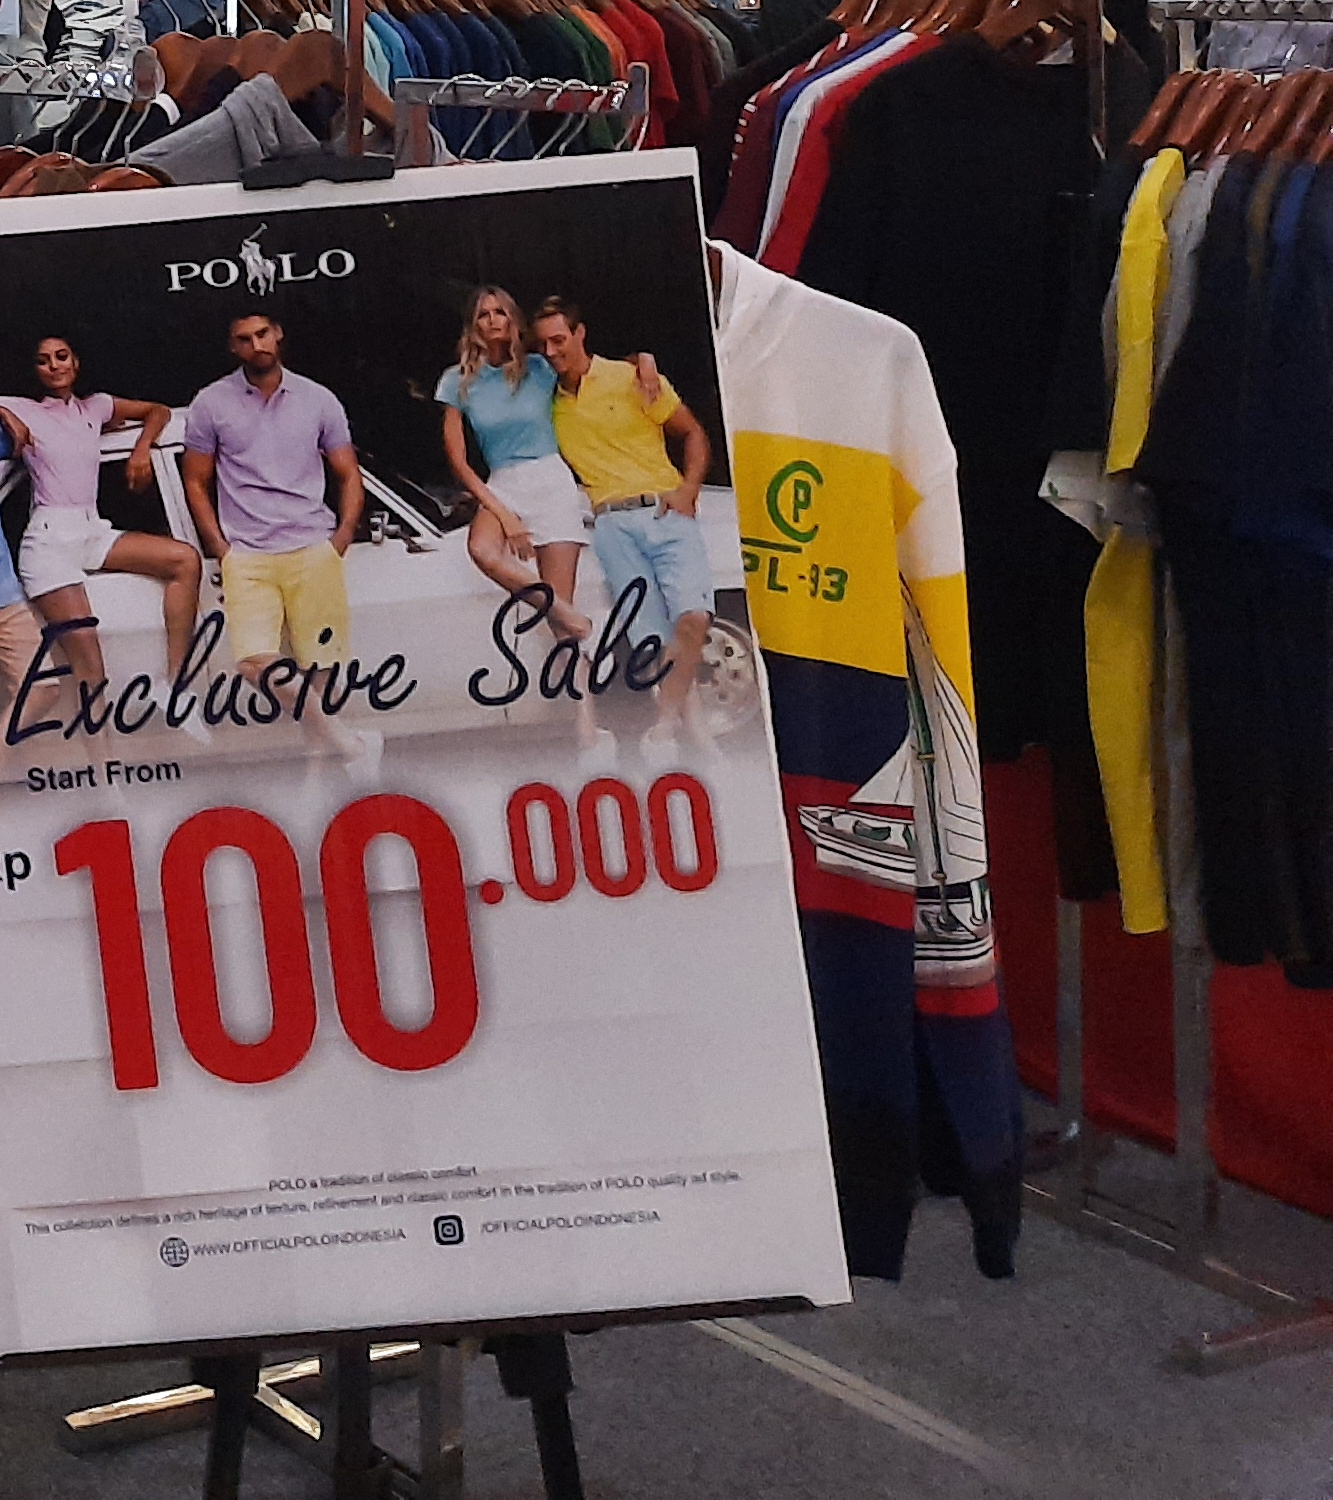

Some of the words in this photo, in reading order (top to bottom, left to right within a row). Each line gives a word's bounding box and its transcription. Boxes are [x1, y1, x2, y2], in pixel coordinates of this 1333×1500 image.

[164, 247, 357, 292] POLO
[4, 608, 418, 747] Exclusive
[468, 575, 676, 707] Sale
[25, 764, 98, 793] Start
[105, 758, 182, 787] From
